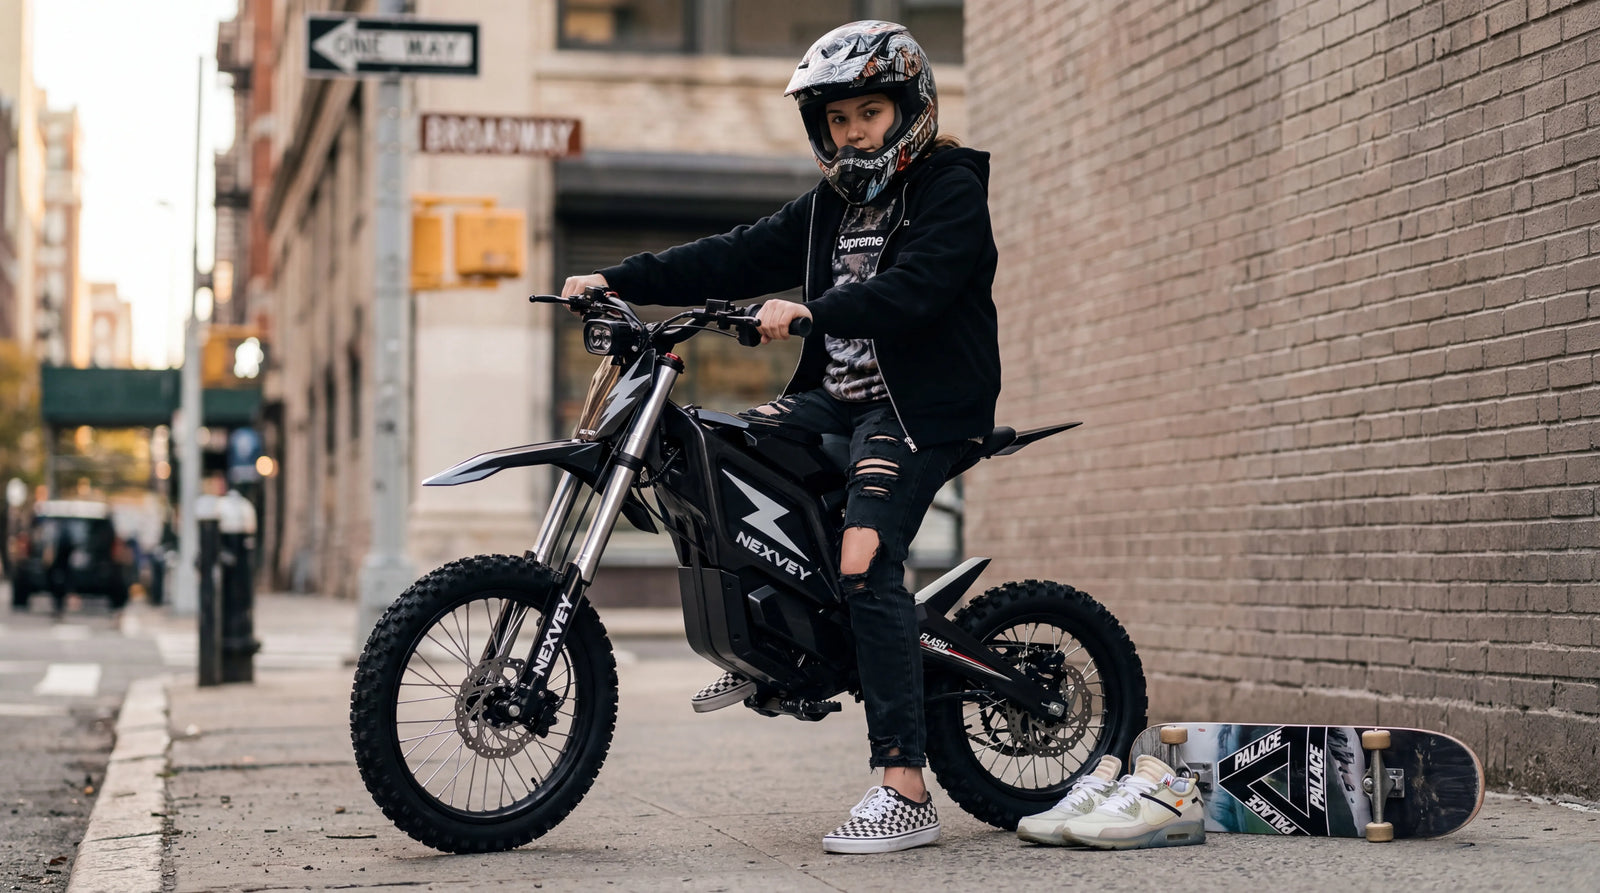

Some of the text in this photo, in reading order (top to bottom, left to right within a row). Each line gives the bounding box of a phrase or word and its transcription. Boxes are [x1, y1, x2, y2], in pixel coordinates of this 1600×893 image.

[334, 32, 461, 62] ONE WAY
[424, 115, 574, 155] BROADWAY
[838, 235, 883, 252] Supreme
[735, 530, 812, 580] NEXVEY
[532, 593, 573, 677] NEXVEY
[919, 632, 949, 650] FLASH
[1234, 730, 1282, 771] PALACE
[1308, 743, 1326, 812] PALACE
[1244, 793, 1298, 835] PALACE
